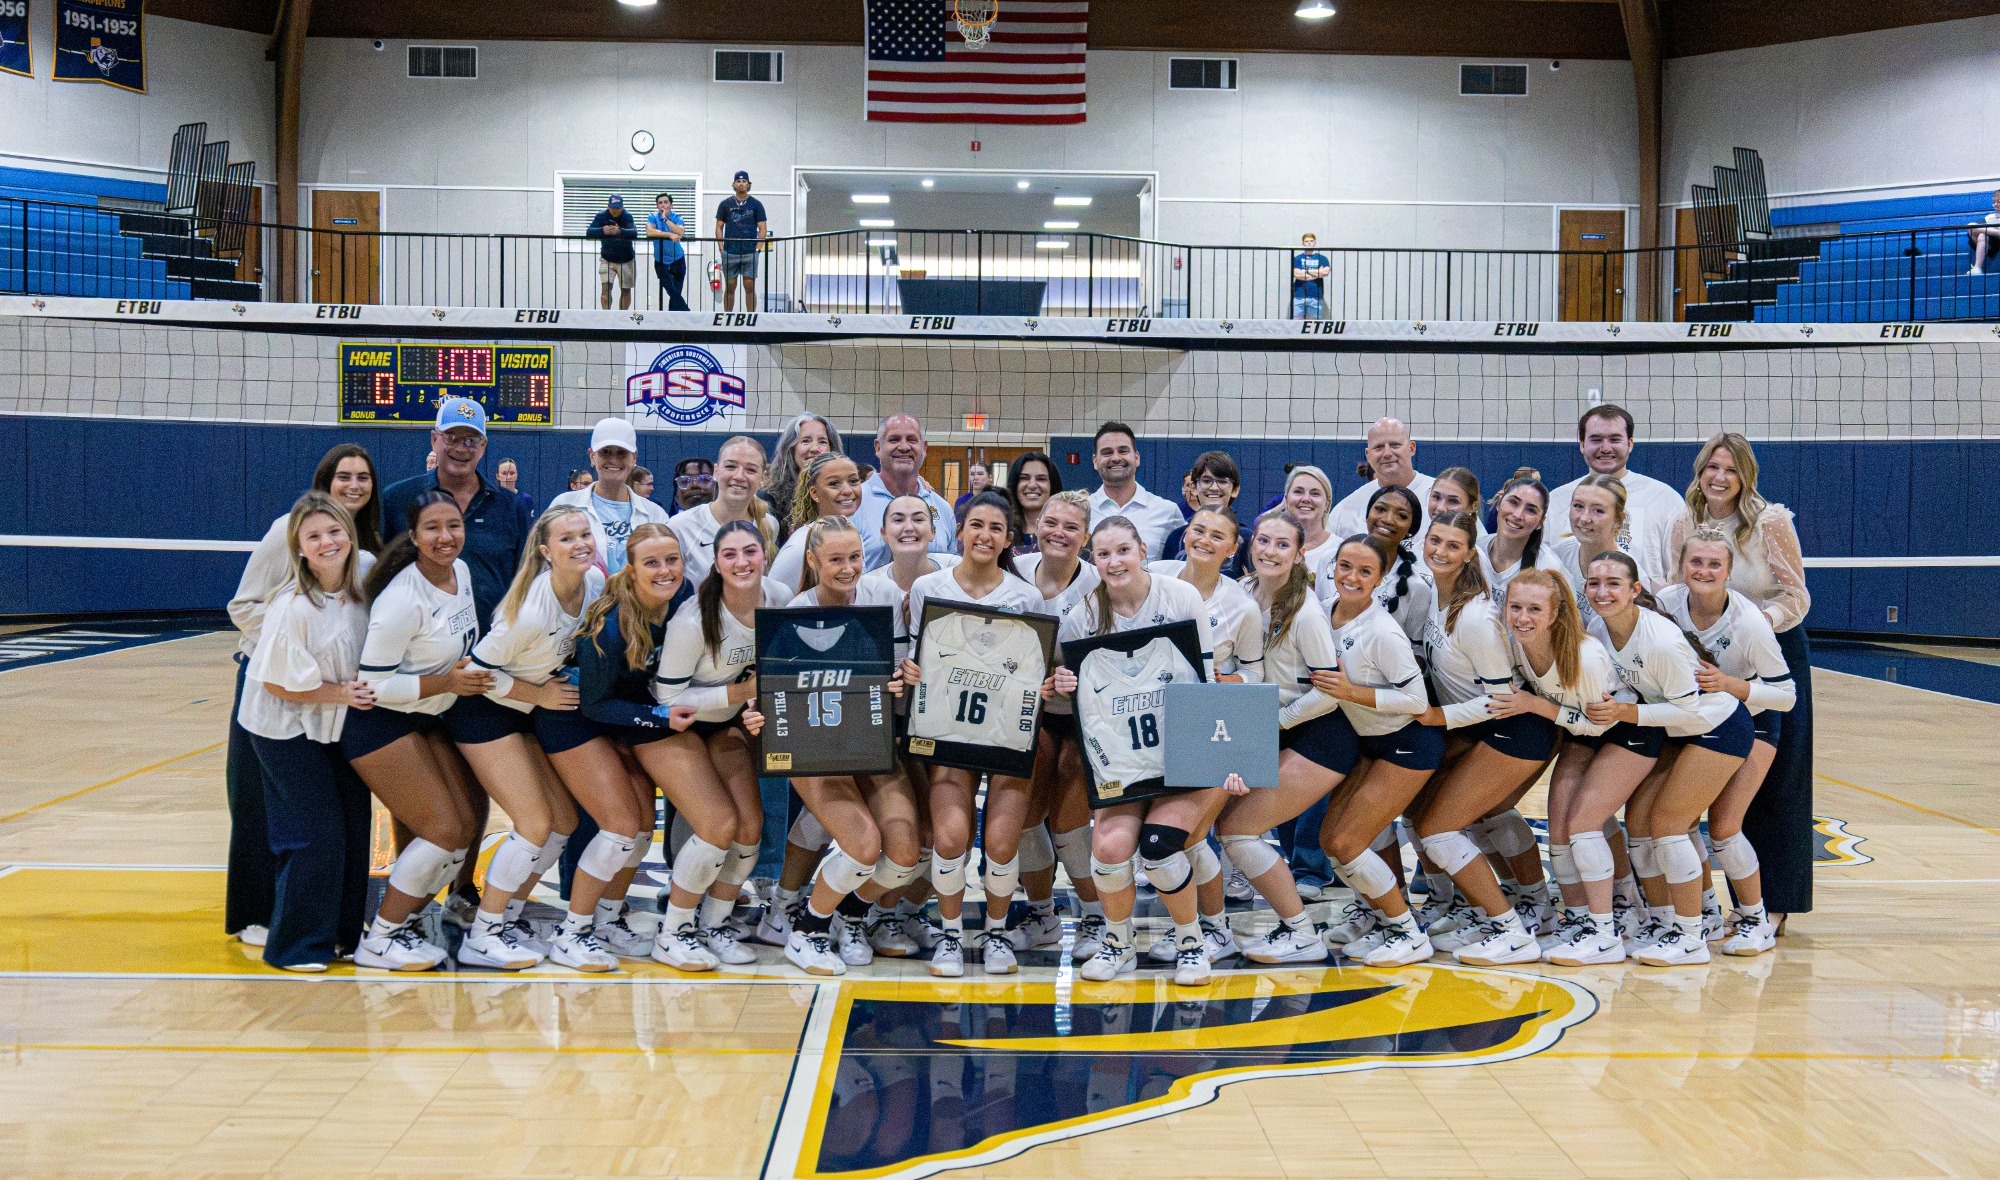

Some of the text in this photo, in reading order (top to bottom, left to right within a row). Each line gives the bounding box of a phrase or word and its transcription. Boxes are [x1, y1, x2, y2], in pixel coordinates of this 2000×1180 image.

[64, 10, 137, 36] 1951-1952
[117, 301, 161, 314] ETBU
[317, 306, 361, 318] ETBU
[515, 310, 560, 323] ETBU
[713, 313, 758, 326] ETBU
[910, 317, 955, 330] ETBU
[1107, 320, 1151, 332] ETBU
[1302, 321, 1346, 334] ETBU
[1495, 323, 1539, 335] ETBU
[1688, 324, 1732, 336] ETBU
[1880, 325, 1924, 337] ETBU
[350, 351, 392, 366] HOME
[501, 354, 548, 369] VISITOR
[375, 372, 394, 404] 0
[530, 375, 549, 407] 0
[627, 369, 745, 409] ASC
[405, 395, 411, 403] 1
[418, 395, 425, 403] 2
[480, 395, 487, 404] 4
[350, 411, 376, 419] BONUS
[517, 413, 542, 422] BONUS
[661, 406, 710, 420] CONFERENCE
[797, 669, 852, 689] ETBU
[948, 667, 1006, 691] ETBU
[774, 691, 787, 715] PHIL
[807, 691, 842, 727] 15
[870, 685, 883, 725] GO BLUE
[955, 690, 988, 725] 16
[1112, 689, 1165, 715] ETBU
[1019, 690, 1036, 732] GO BLUE
[1128, 713, 1159, 750] 18
[1210, 719, 1232, 742] A
[1088, 736, 1110, 767] JESUS WON
